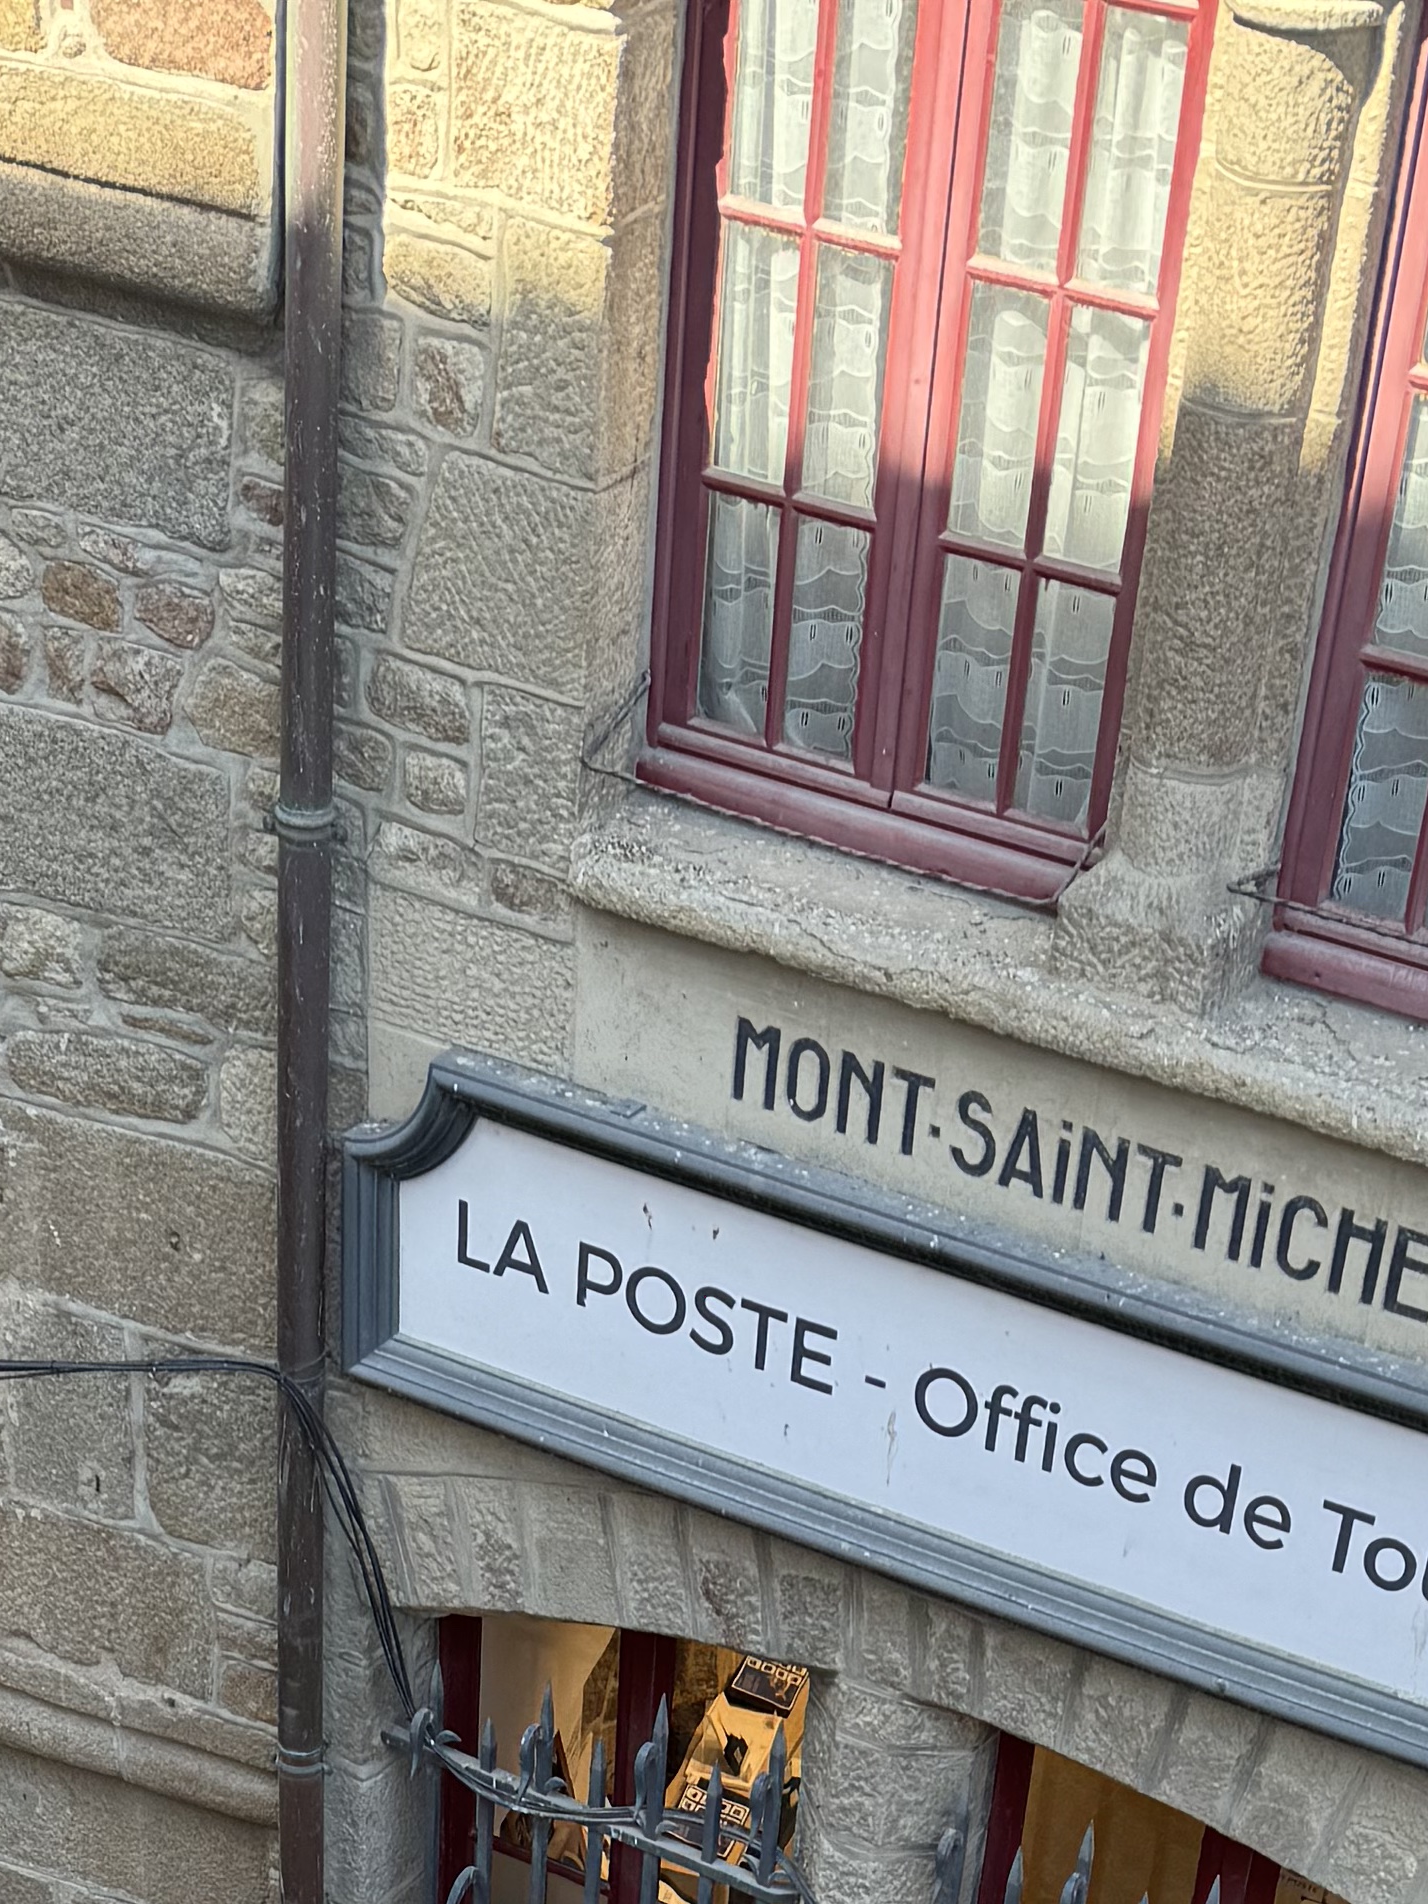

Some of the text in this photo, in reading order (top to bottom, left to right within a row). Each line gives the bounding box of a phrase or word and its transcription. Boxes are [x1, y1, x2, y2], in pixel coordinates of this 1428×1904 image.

[457, 1198, 550, 1295] LA
[575, 1240, 839, 1396] POSTE
[914, 1366, 1158, 1503] Office
[1183, 1463, 1292, 1550] de
